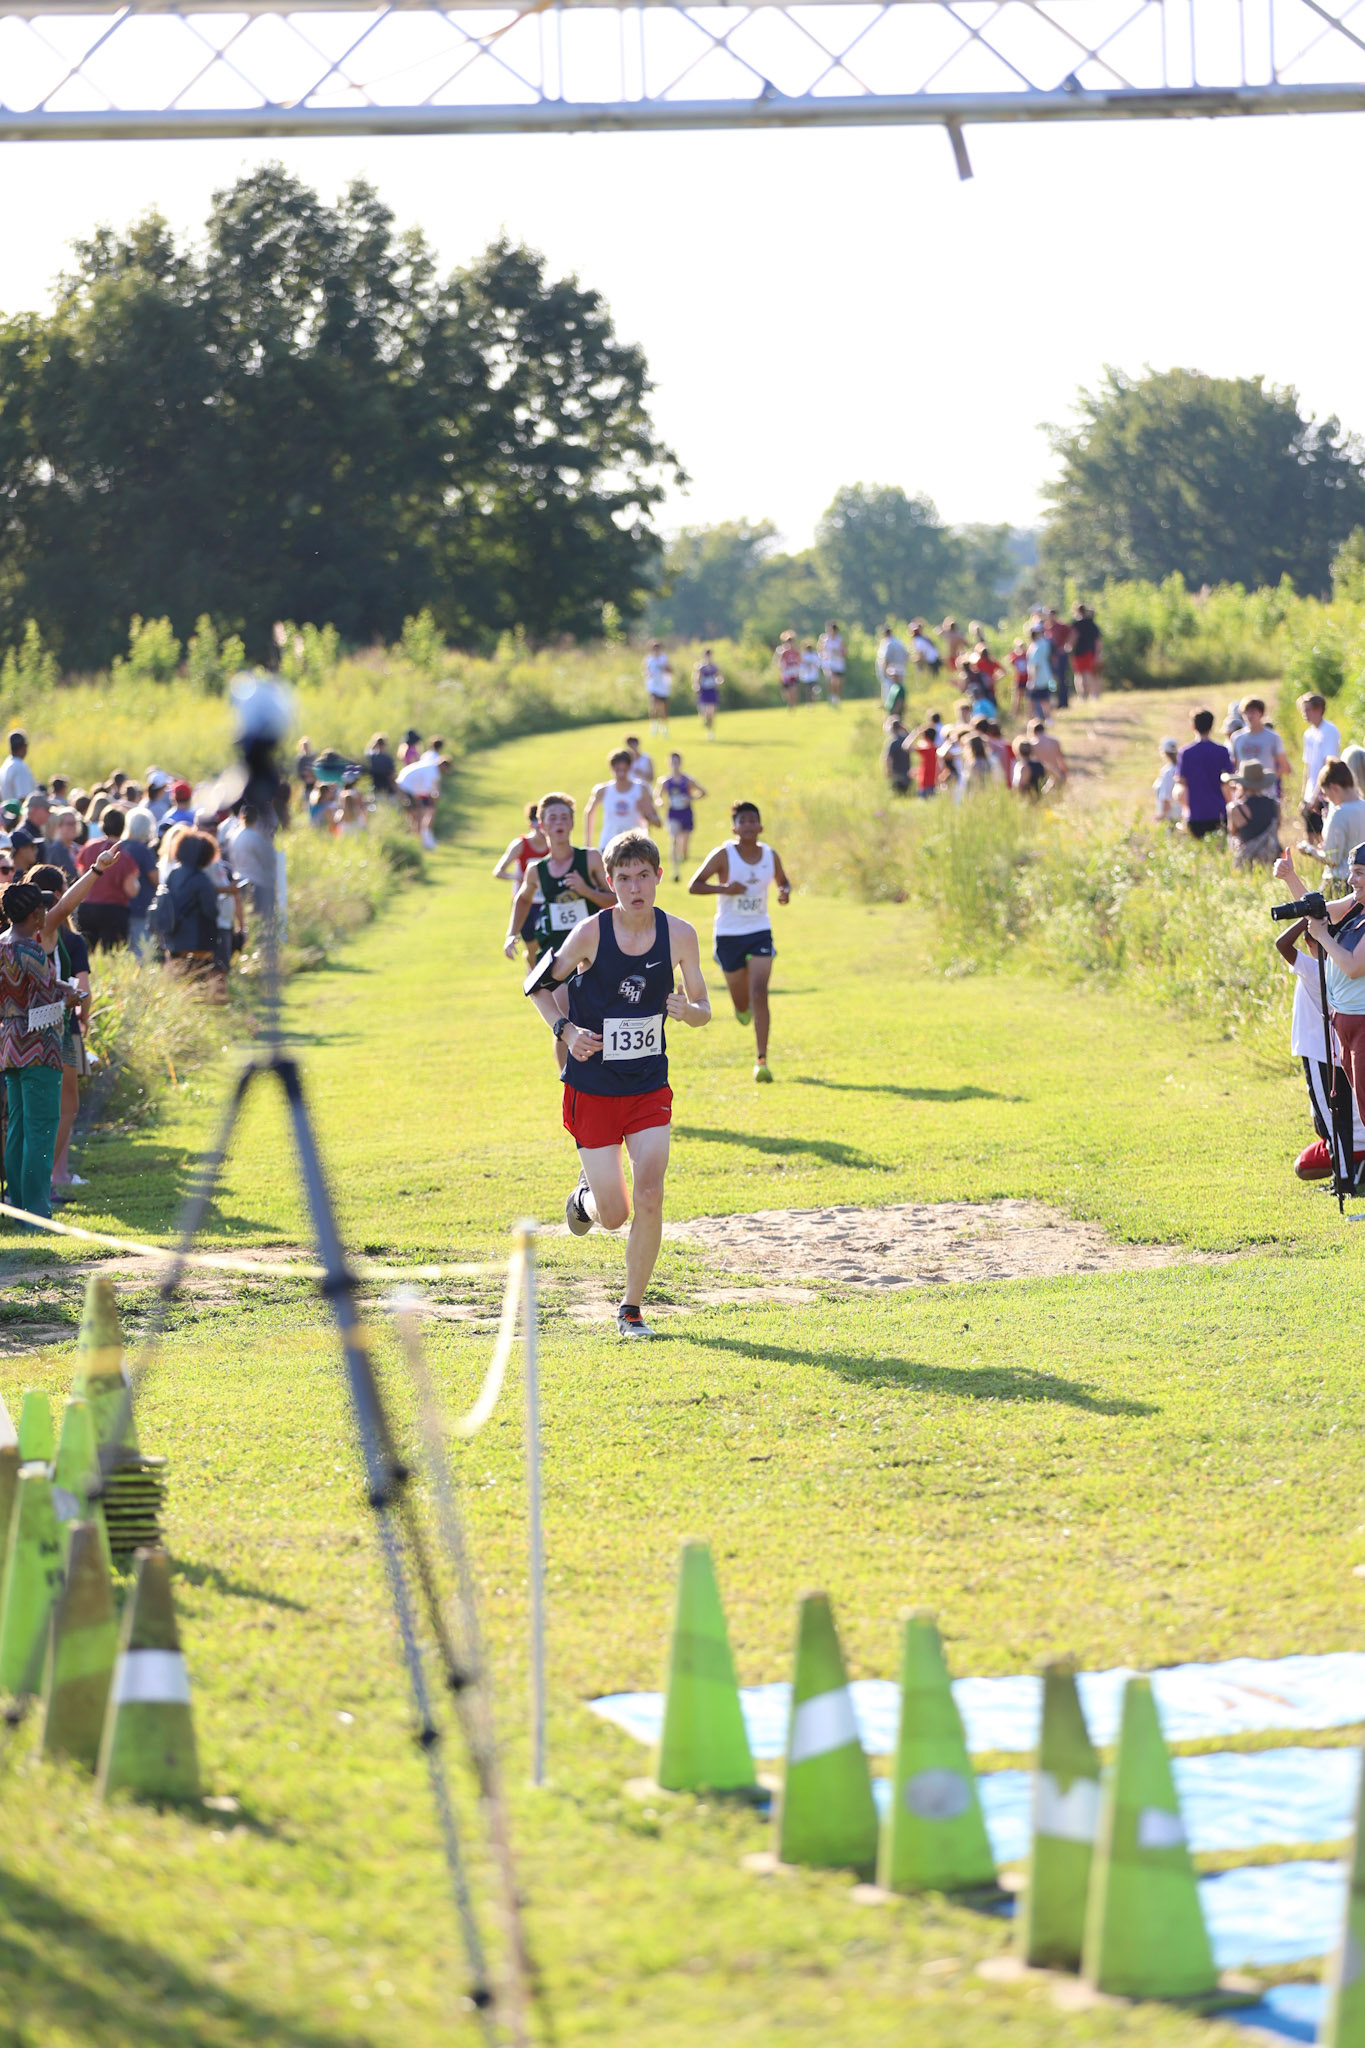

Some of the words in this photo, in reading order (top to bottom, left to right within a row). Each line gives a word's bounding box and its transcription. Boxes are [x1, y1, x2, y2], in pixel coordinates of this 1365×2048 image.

[560, 910, 577, 924] 65
[620, 981, 641, 1002] SBA
[610, 1028, 655, 1051] 1336
